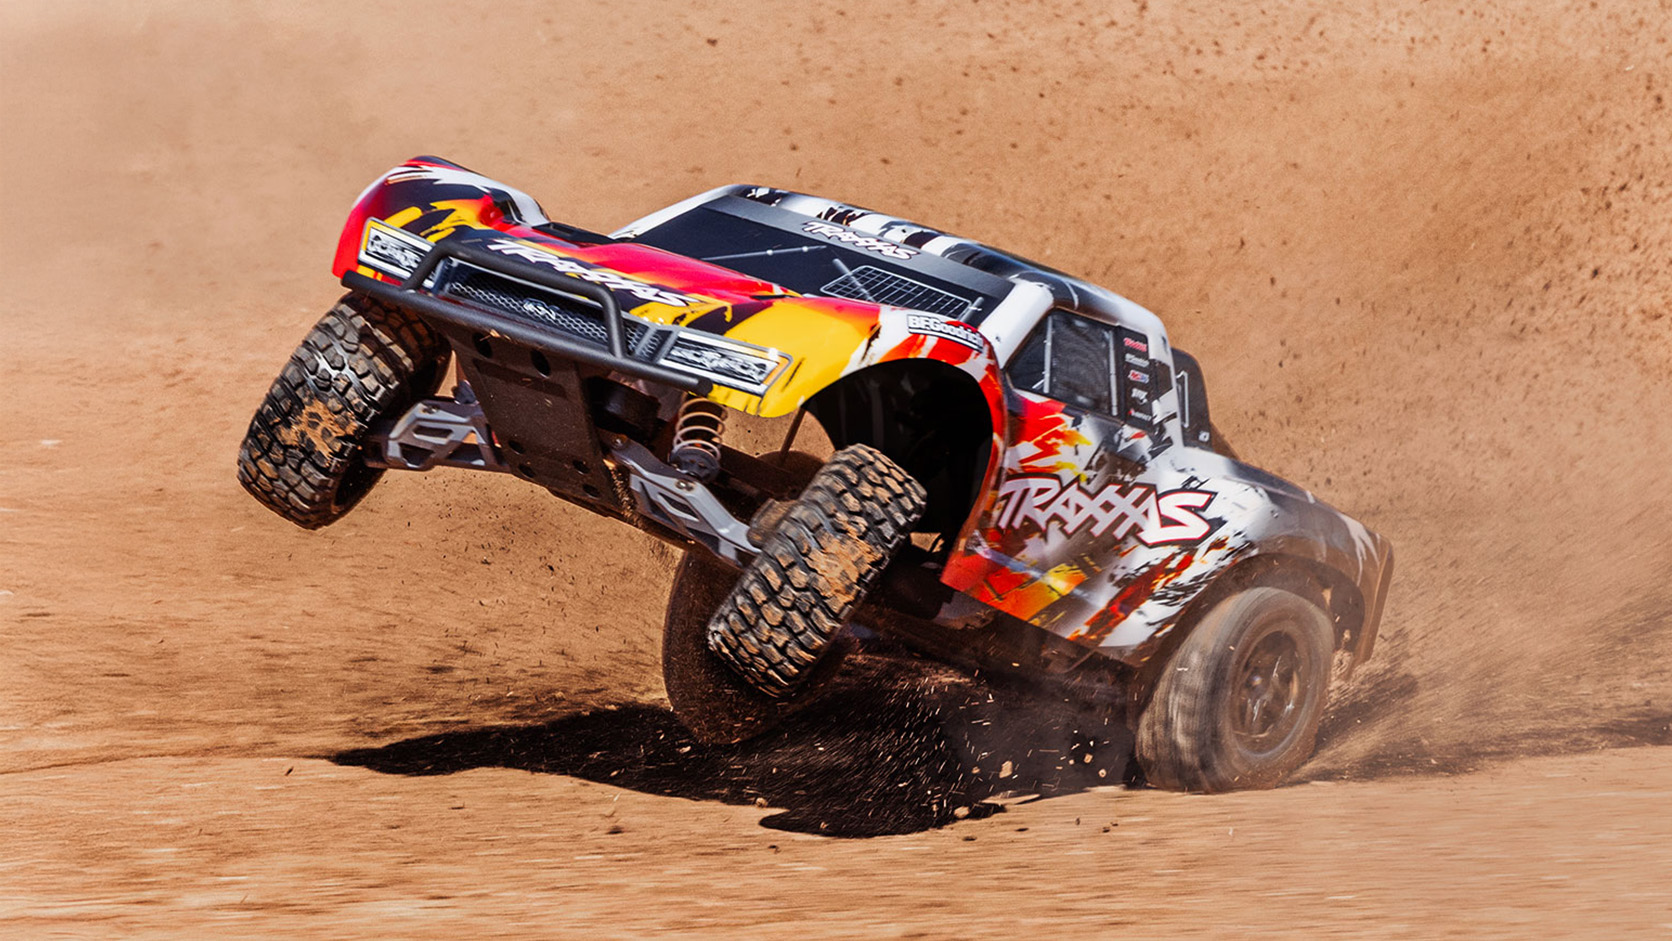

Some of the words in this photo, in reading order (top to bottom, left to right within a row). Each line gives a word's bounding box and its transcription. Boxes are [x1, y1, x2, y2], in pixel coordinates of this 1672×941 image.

[803, 221, 920, 260] TRAXXAS
[487, 239, 701, 307] TRAXXAS
[907, 314, 984, 349] BFGoodrich
[997, 475, 1215, 547] TRAXXAS
